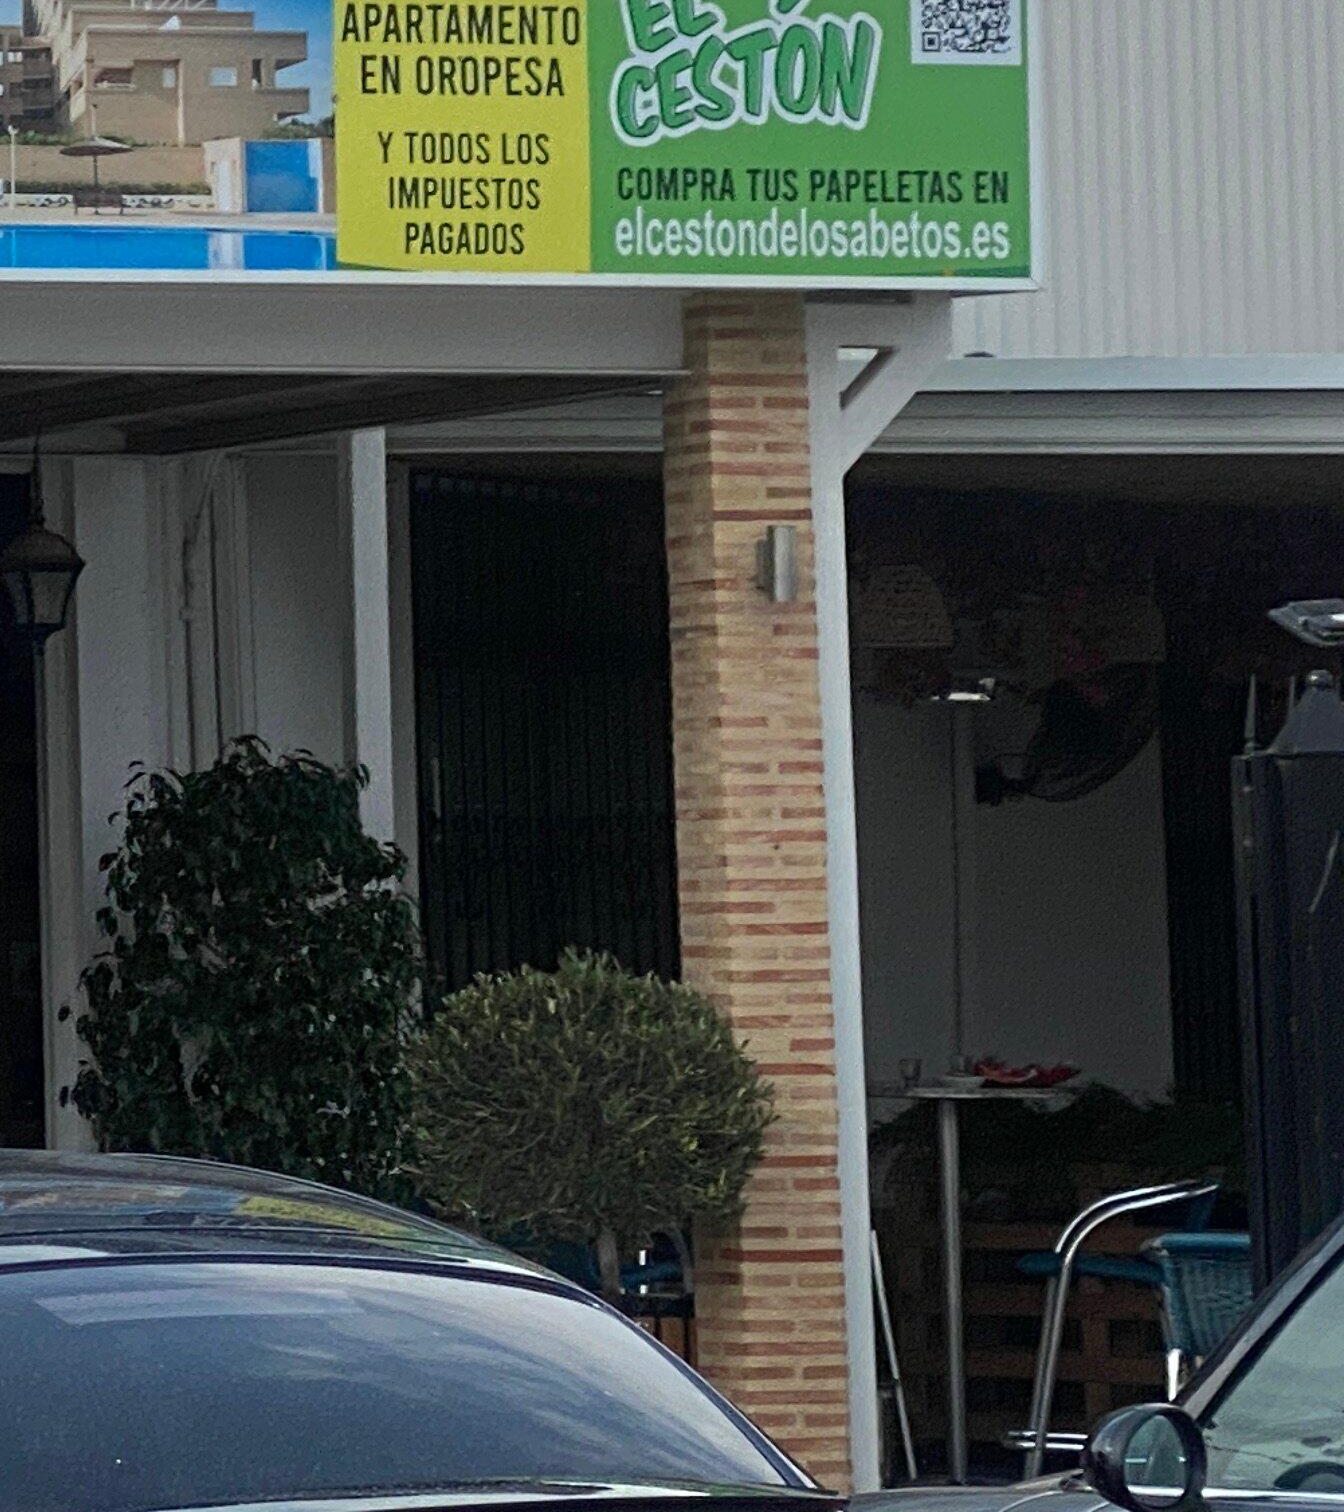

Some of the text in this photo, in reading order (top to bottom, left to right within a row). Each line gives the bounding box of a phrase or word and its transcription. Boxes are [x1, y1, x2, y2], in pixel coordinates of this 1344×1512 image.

[342, 3, 581, 46] APARTAMENTO
[361, 55, 565, 97] EN OROPESA
[378, 132, 550, 166] Y TODOS LOS
[389, 177, 541, 210] IMPUESTOS
[617, 167, 1009, 204] COMPRA TUS PAPELETAS EN
[404, 223, 525, 255] PAGADOS
[615, 206, 1010, 259] elcestondelosabetos.es
